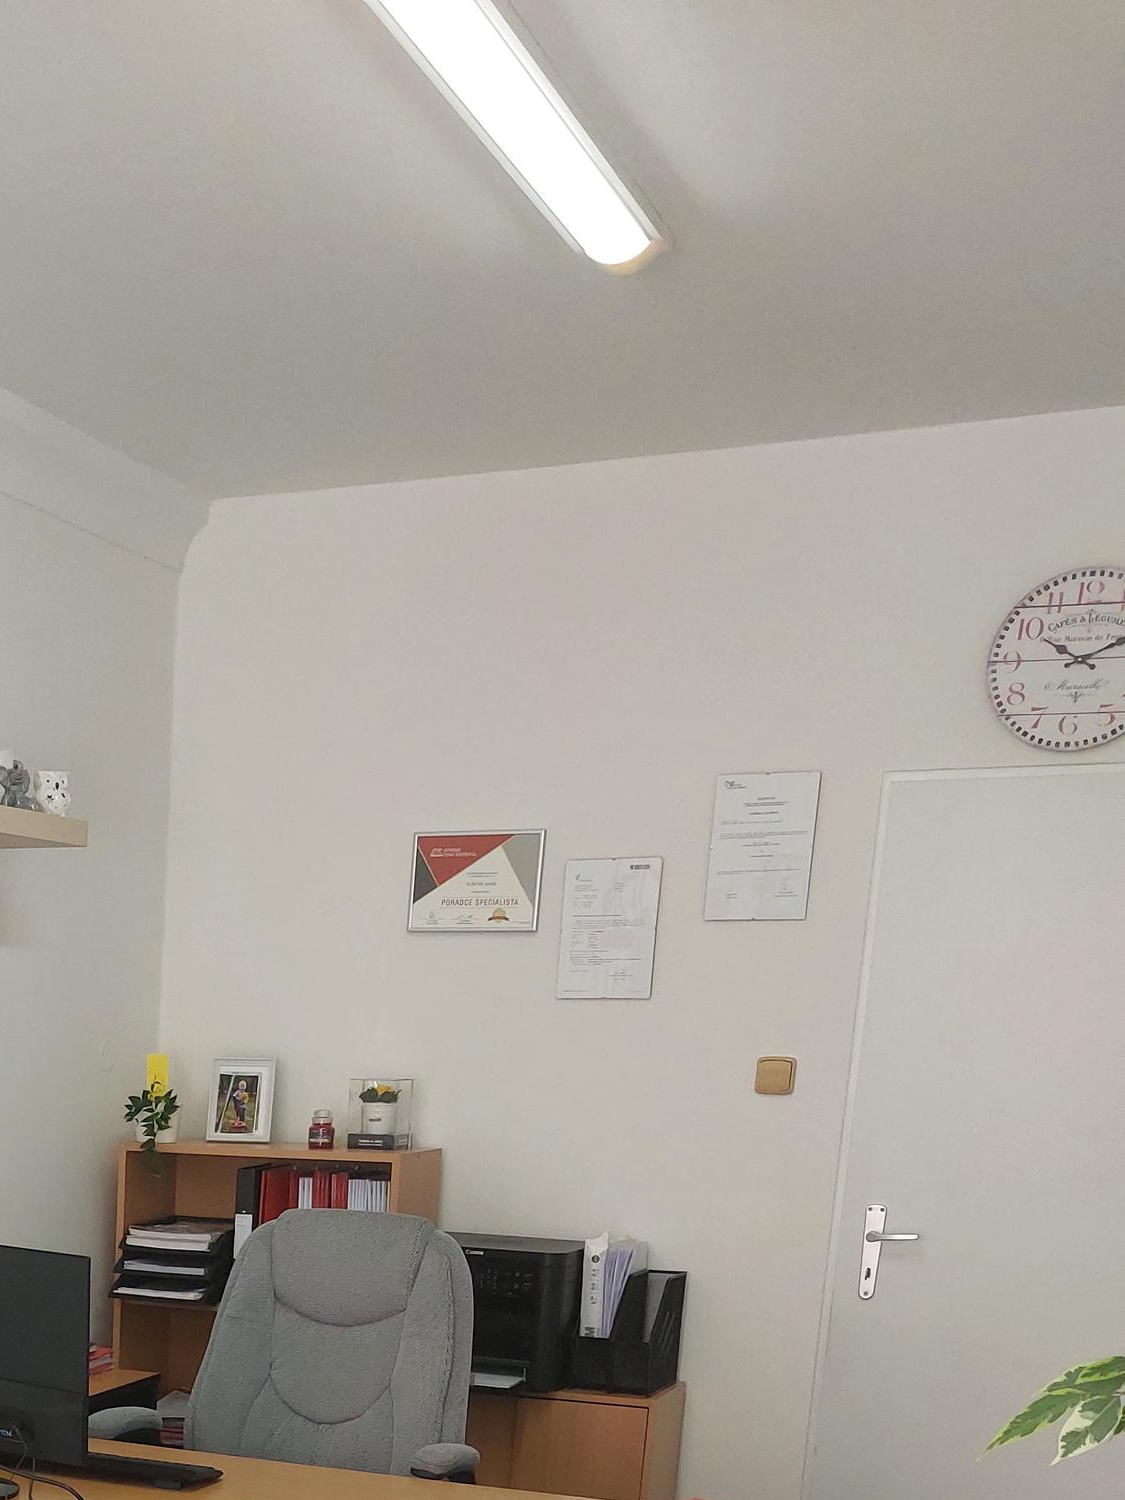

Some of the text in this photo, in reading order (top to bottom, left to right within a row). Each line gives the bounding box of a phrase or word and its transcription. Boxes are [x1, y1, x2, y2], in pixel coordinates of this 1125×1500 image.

[1047, 591, 1064, 614] 11
[1078, 580, 1105, 605] 12
[1017, 616, 1044, 641] 10
[1003, 650, 1022, 673] 9
[1006, 682, 1025, 706] 8
[1031, 706, 1049, 729] 7
[1058, 715, 1078, 735] 6
[1097, 703, 1115, 726] 5
[441, 898, 519, 906] PORADCE SPECIALISTA
